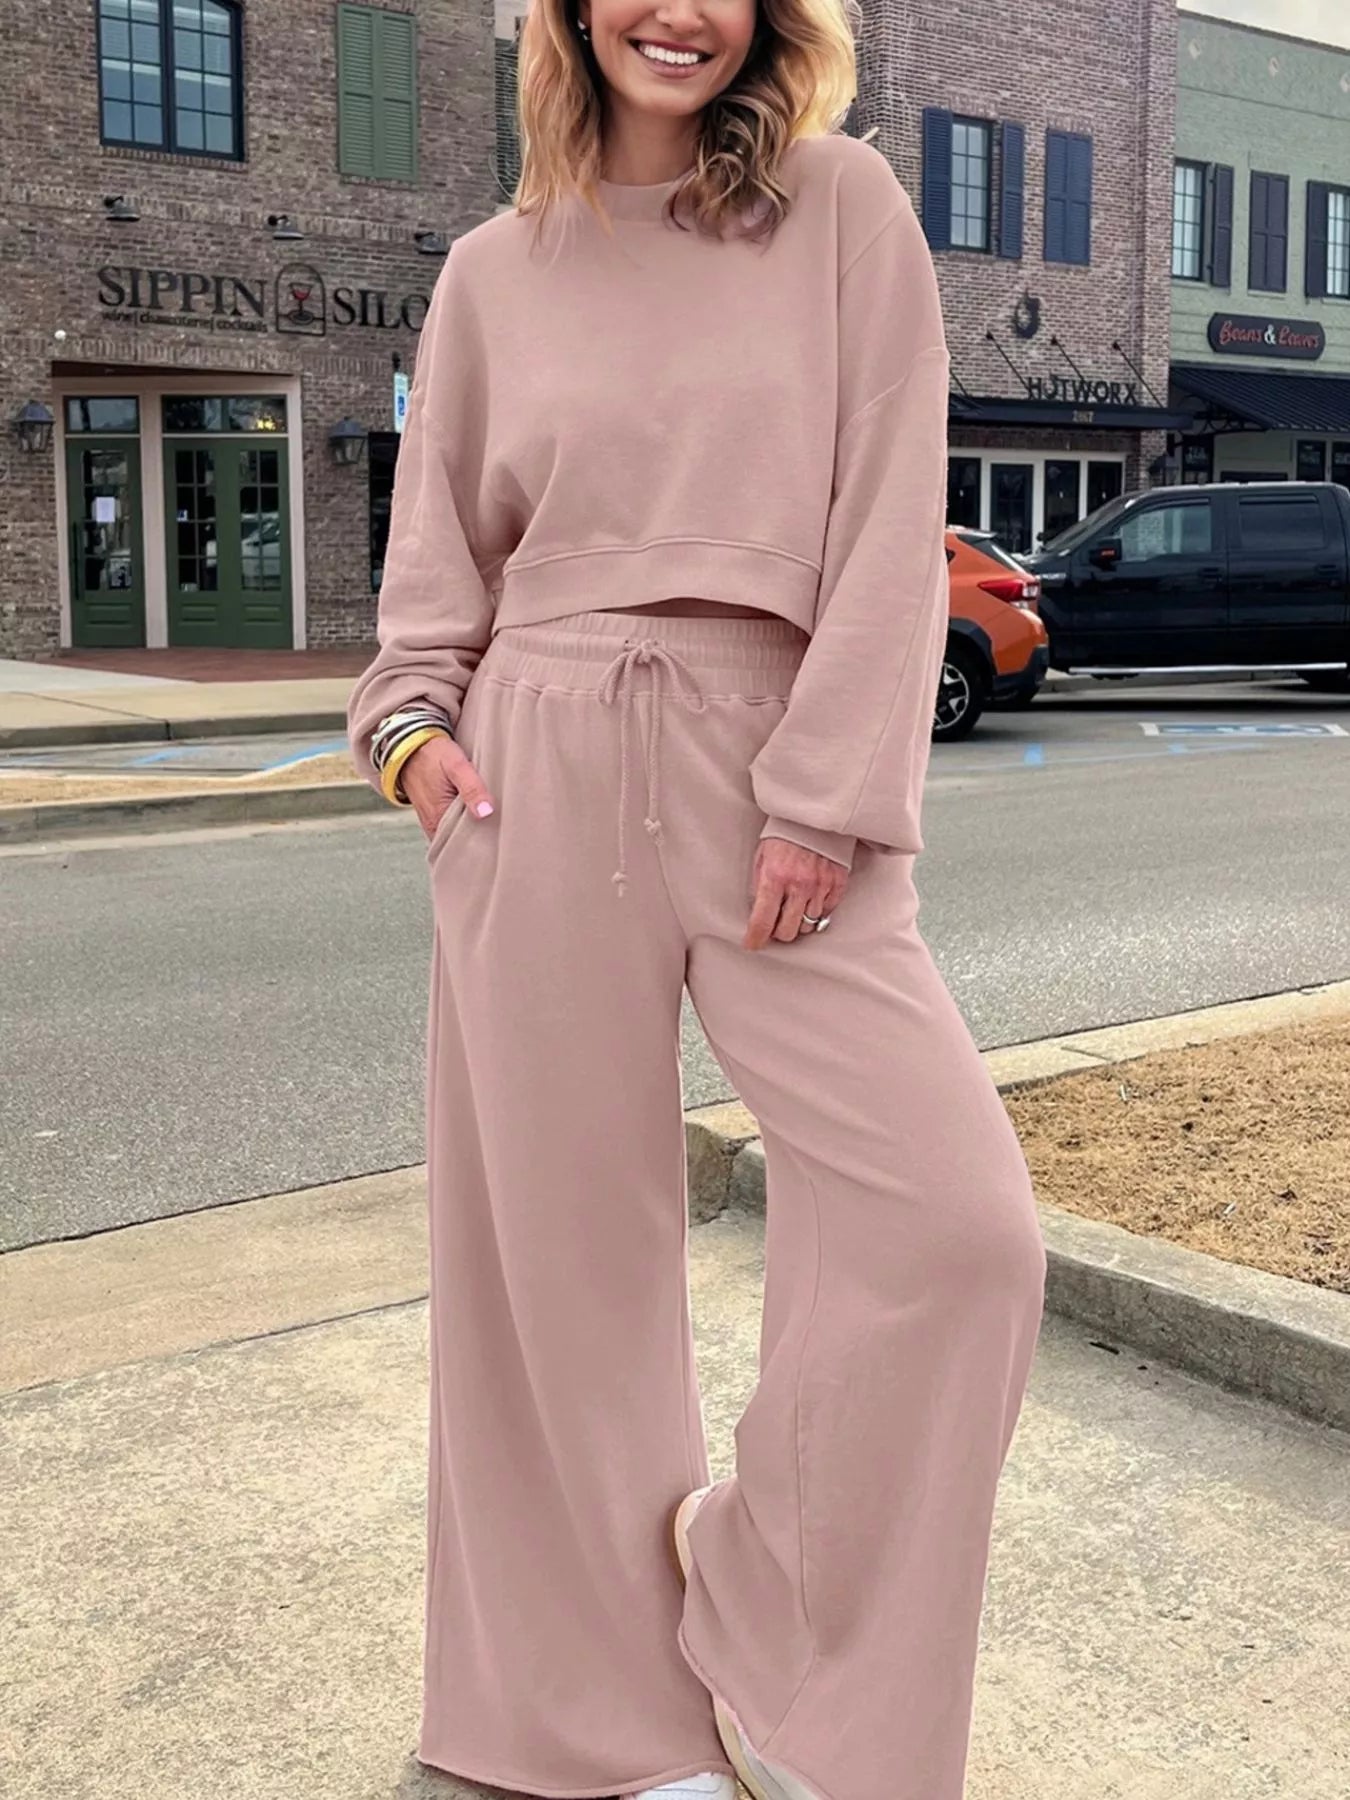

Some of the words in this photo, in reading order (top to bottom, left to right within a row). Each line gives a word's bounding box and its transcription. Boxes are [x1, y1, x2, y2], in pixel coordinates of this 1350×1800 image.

[98, 266, 267, 317] SIPPIN
[333, 287, 429, 332] SILO
[1219, 320, 1262, 345] Beans
[1264, 324, 1277, 345] &
[1028, 375, 1136, 405] HOTWORX
